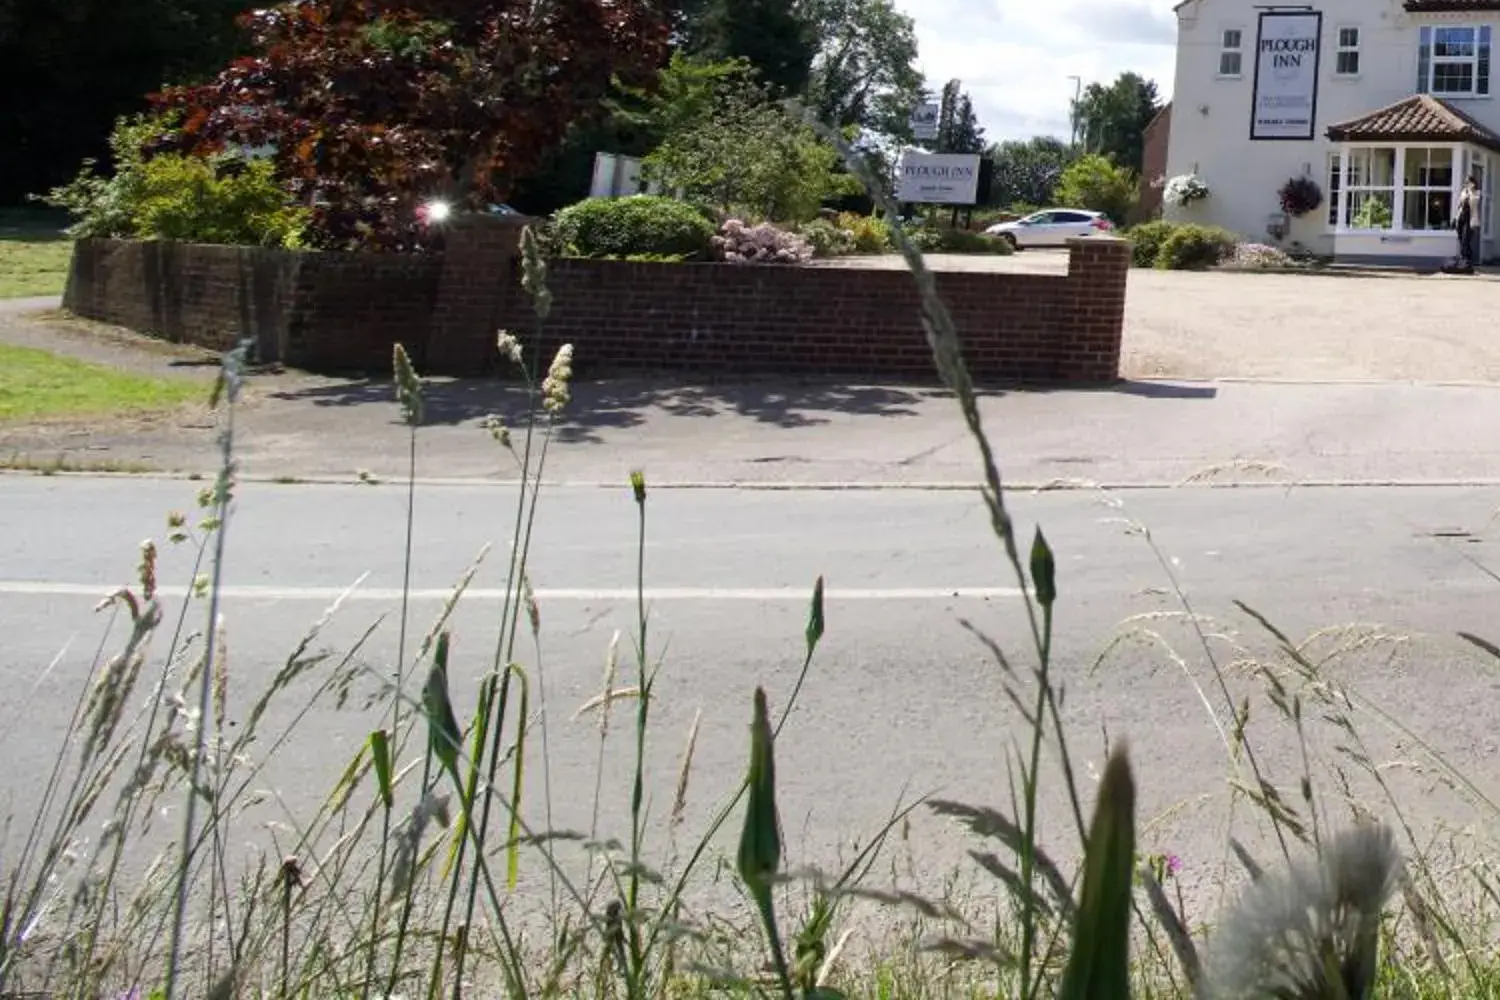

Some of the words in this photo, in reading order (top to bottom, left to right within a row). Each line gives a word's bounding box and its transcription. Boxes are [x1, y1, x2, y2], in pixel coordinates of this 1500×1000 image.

[1261, 39, 1315, 53] PLOUGH
[1273, 54, 1301, 68] INN
[905, 166, 949, 178] PLOUGH
[952, 166, 973, 178] INN
